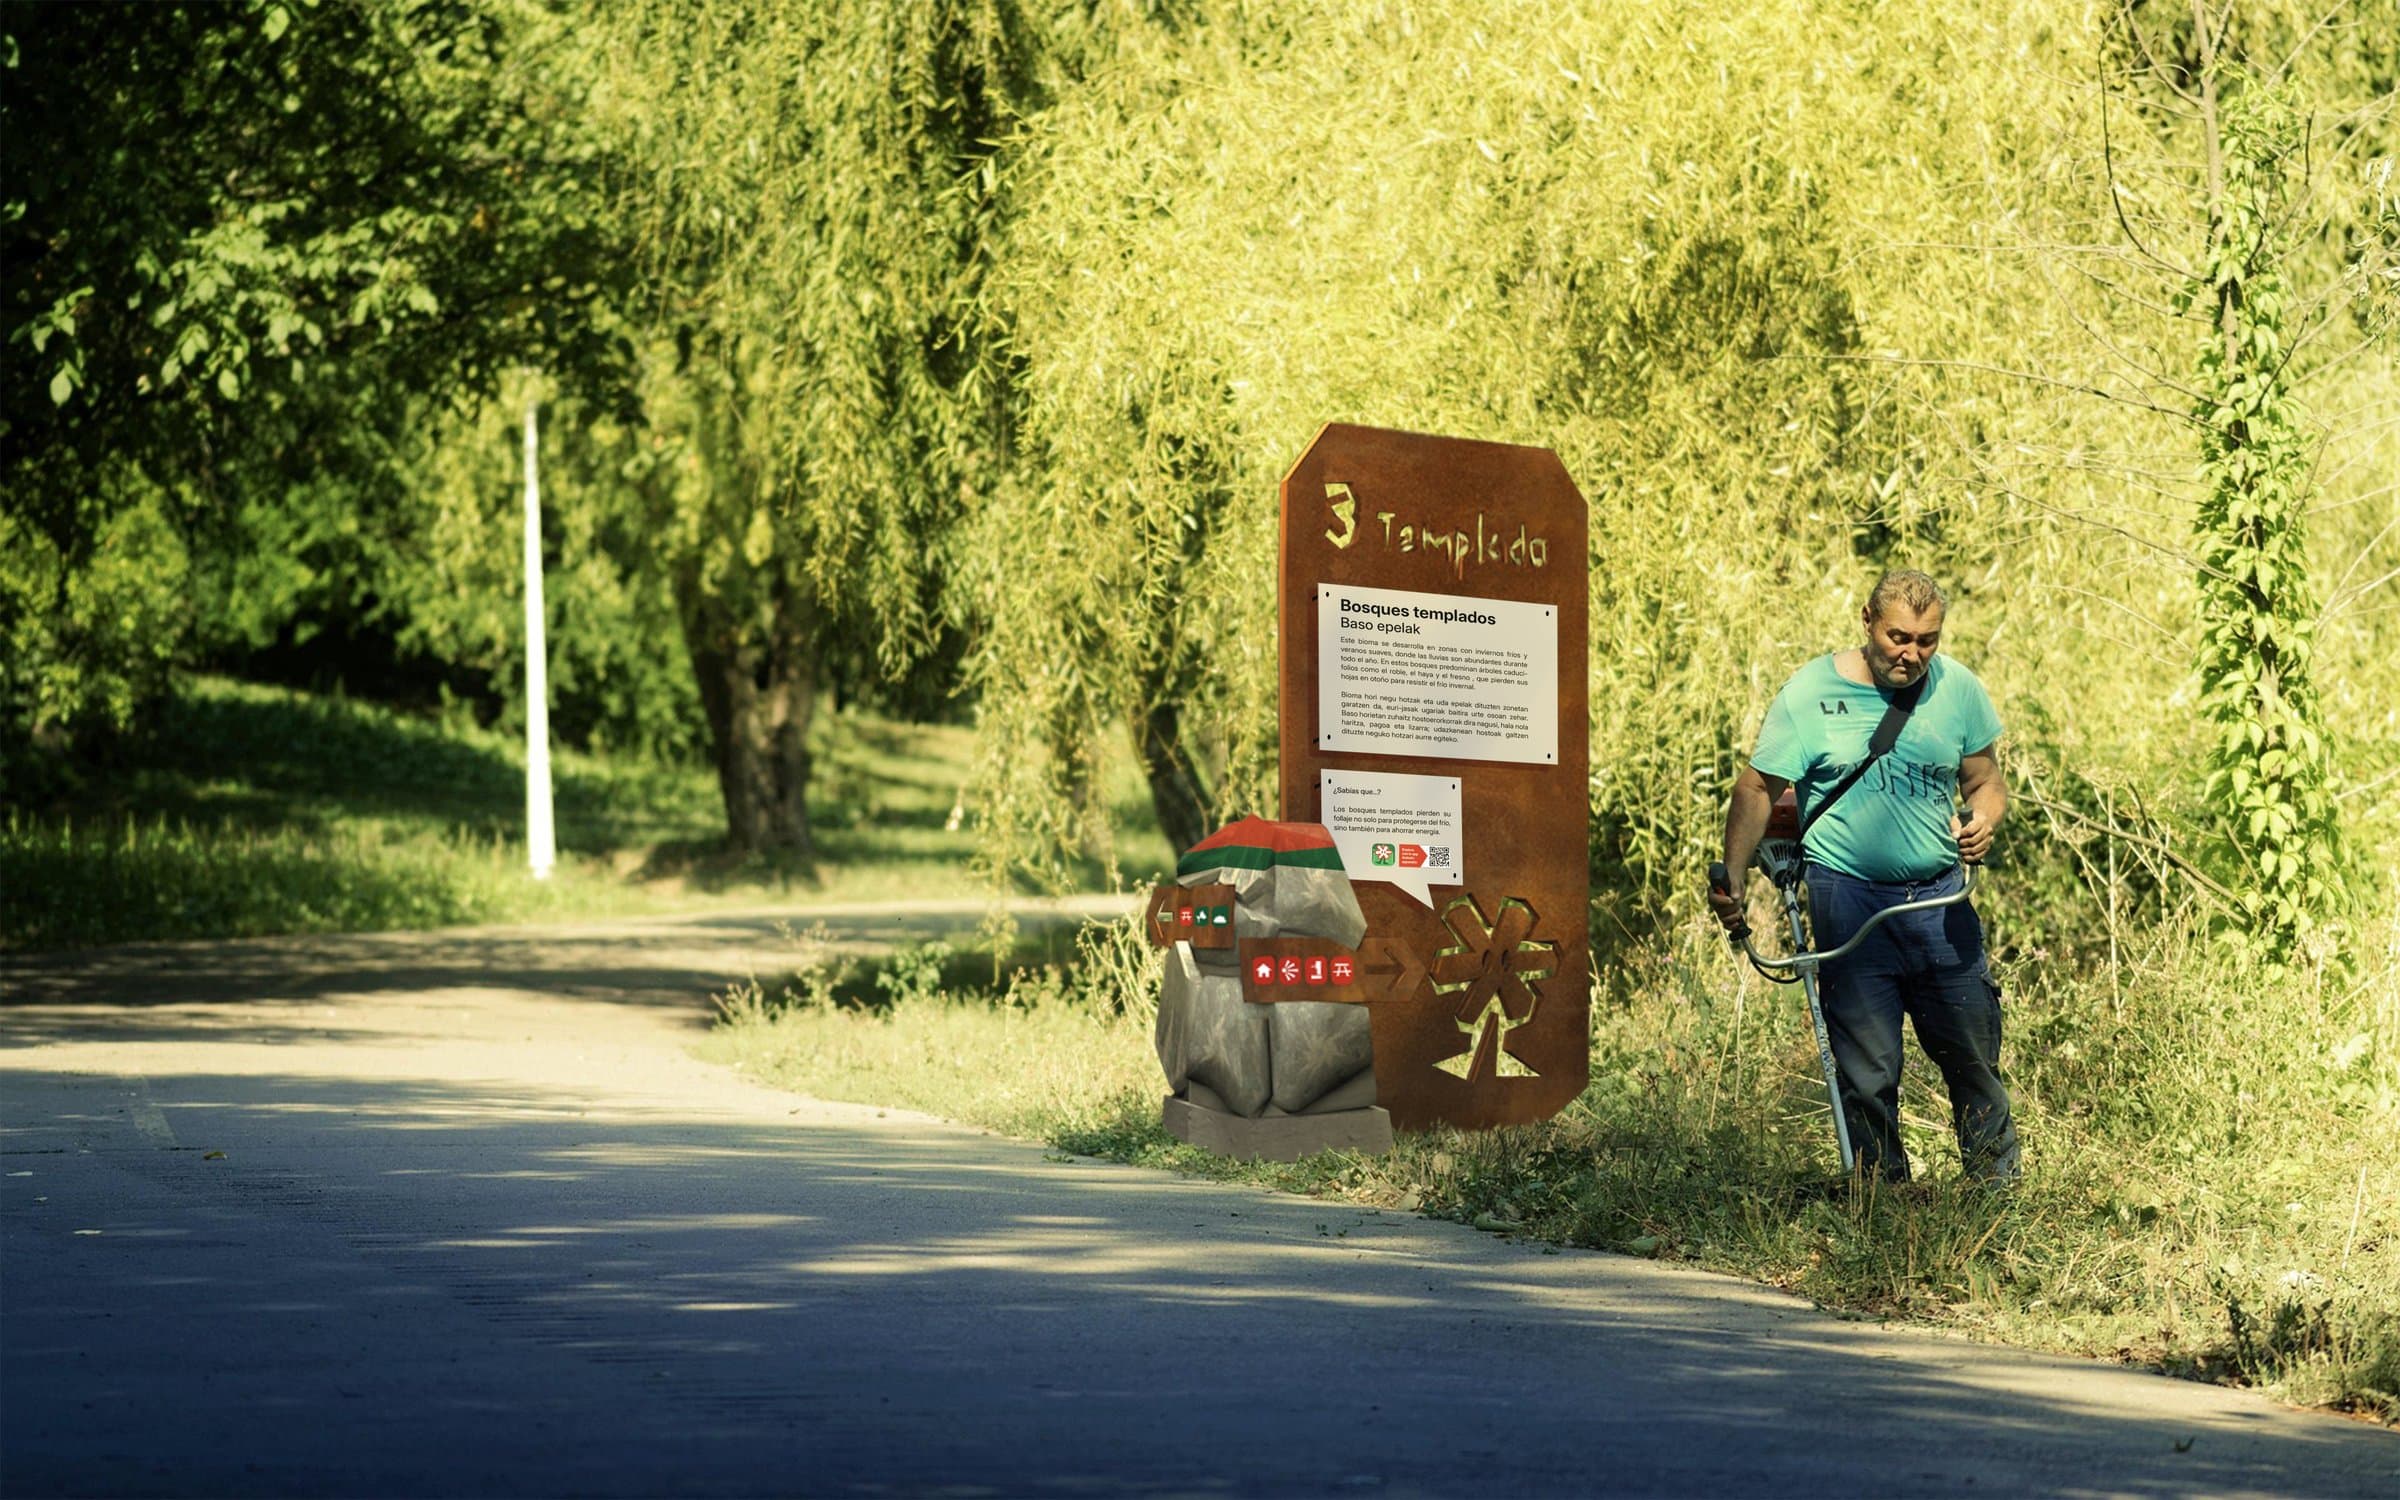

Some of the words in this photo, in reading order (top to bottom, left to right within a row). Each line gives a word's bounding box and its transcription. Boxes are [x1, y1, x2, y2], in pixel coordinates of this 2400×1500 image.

[1324, 482, 1357, 550] 3
[1340, 598, 1410, 618] Bosques
[1412, 606, 1496, 626] templados
[1340, 616, 1374, 631] Baso
[1377, 622, 1421, 635] epelak
[1340, 636, 1356, 644] Este
[1357, 638, 1379, 646] bioma
[1392, 641, 1424, 650] desarrolla
[1475, 648, 1504, 657] inviernos
[1340, 655, 1356, 663] todo
[1410, 661, 1438, 670] bosques
[1439, 664, 1478, 673] predominan
[1428, 653, 1449, 662] lluvias
[1464, 657, 1502, 666] abundantes
[1503, 660, 1528, 668] durante
[1340, 663, 1359, 672] folios
[1360, 666, 1380, 674] como
[1417, 670, 1434, 679] haya
[1450, 673, 1471, 681] fresno
[1340, 673, 1359, 681] hojas
[1341, 691, 1362, 699] Bioma
[1398, 696, 1420, 704] hotzak
[1474, 702, 1501, 710] dituzten
[1341, 701, 1370, 709] garatzen
[1819, 700, 1849, 715] LA
[1341, 709, 1358, 718] Baso
[1359, 711, 1386, 719] horietan
[1387, 714, 1411, 722] zuhaitz
[1341, 728, 1364, 736] dituzte
[1365, 730, 1391, 738] neguko
[1369, 722, 1390, 730] pagoa
[1476, 729, 1502, 737] hostoak
[1333, 805, 1346, 813] Los
[1348, 806, 1377, 815] bosques
[1379, 808, 1413, 816] templados
[1416, 809, 1440, 817] pierden
[1333, 814, 1353, 824] follaje
[1393, 818, 1428, 826] protegerse
[1333, 824, 1348, 832] sino
[1348, 825, 1375, 833] también
